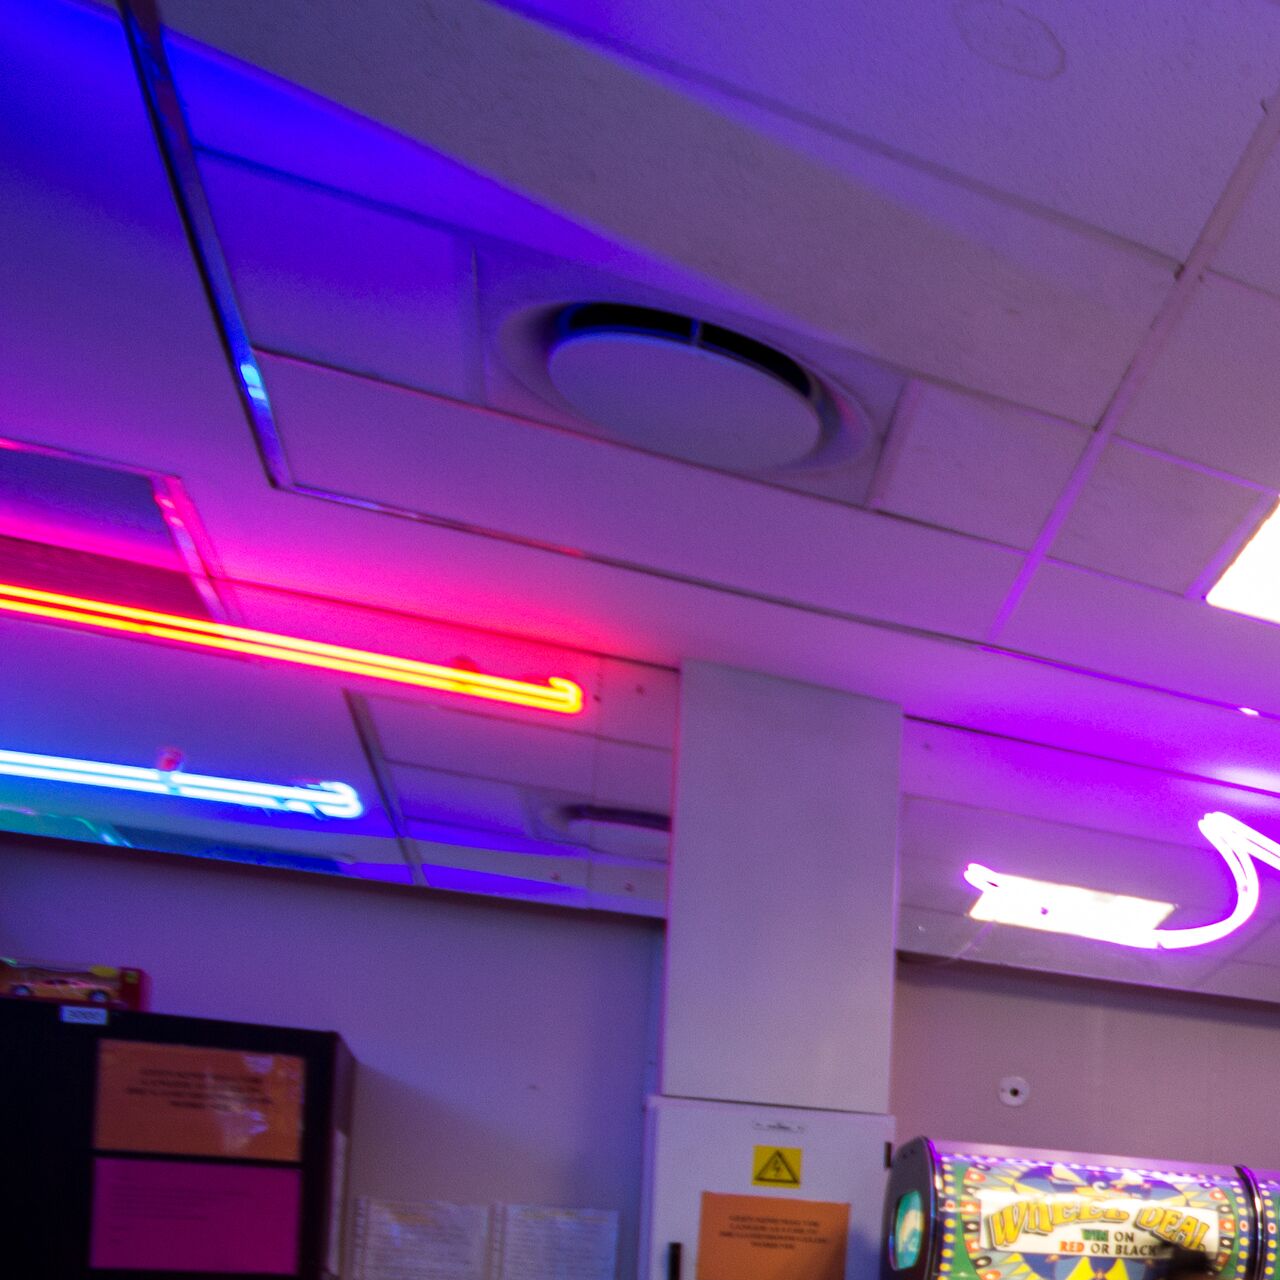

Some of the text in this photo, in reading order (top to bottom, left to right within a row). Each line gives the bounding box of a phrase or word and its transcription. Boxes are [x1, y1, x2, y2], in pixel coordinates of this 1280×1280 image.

[986, 1199, 1210, 1252] WHEEL DEAL
[1081, 1228, 1135, 1244] WIN ON
[1058, 1240, 1156, 1257] RED OR BLACK
